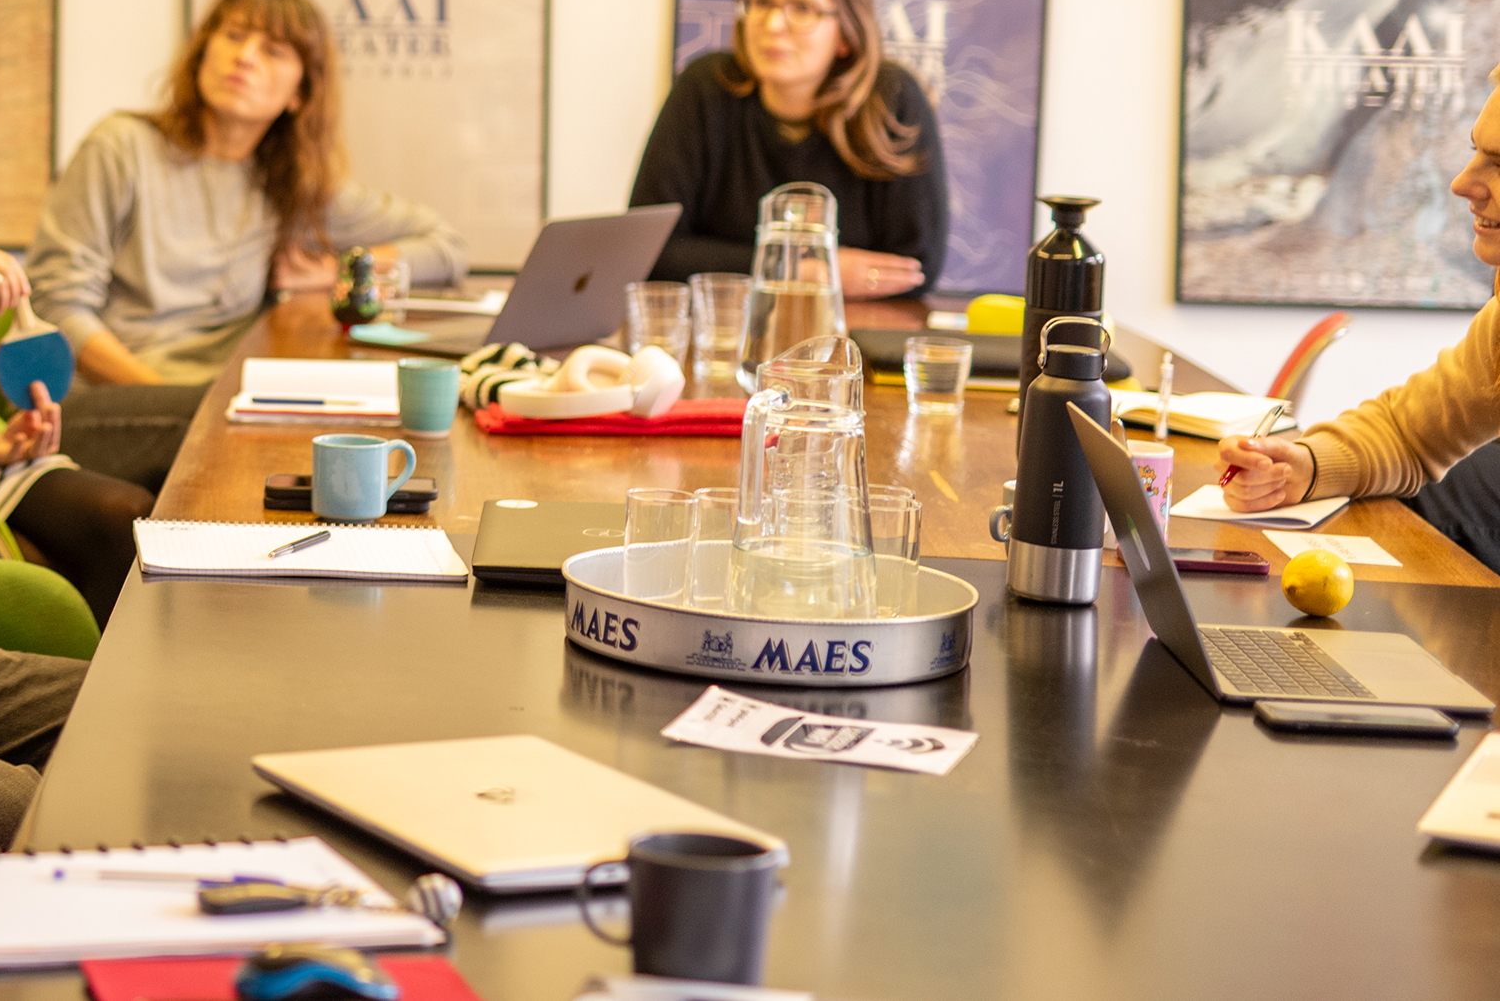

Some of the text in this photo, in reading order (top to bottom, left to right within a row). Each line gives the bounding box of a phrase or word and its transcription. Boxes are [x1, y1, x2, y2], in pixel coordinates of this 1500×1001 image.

[1285, 9, 1466, 55] KAAI
[571, 599, 641, 651] MAES
[750, 637, 877, 677] MAES
